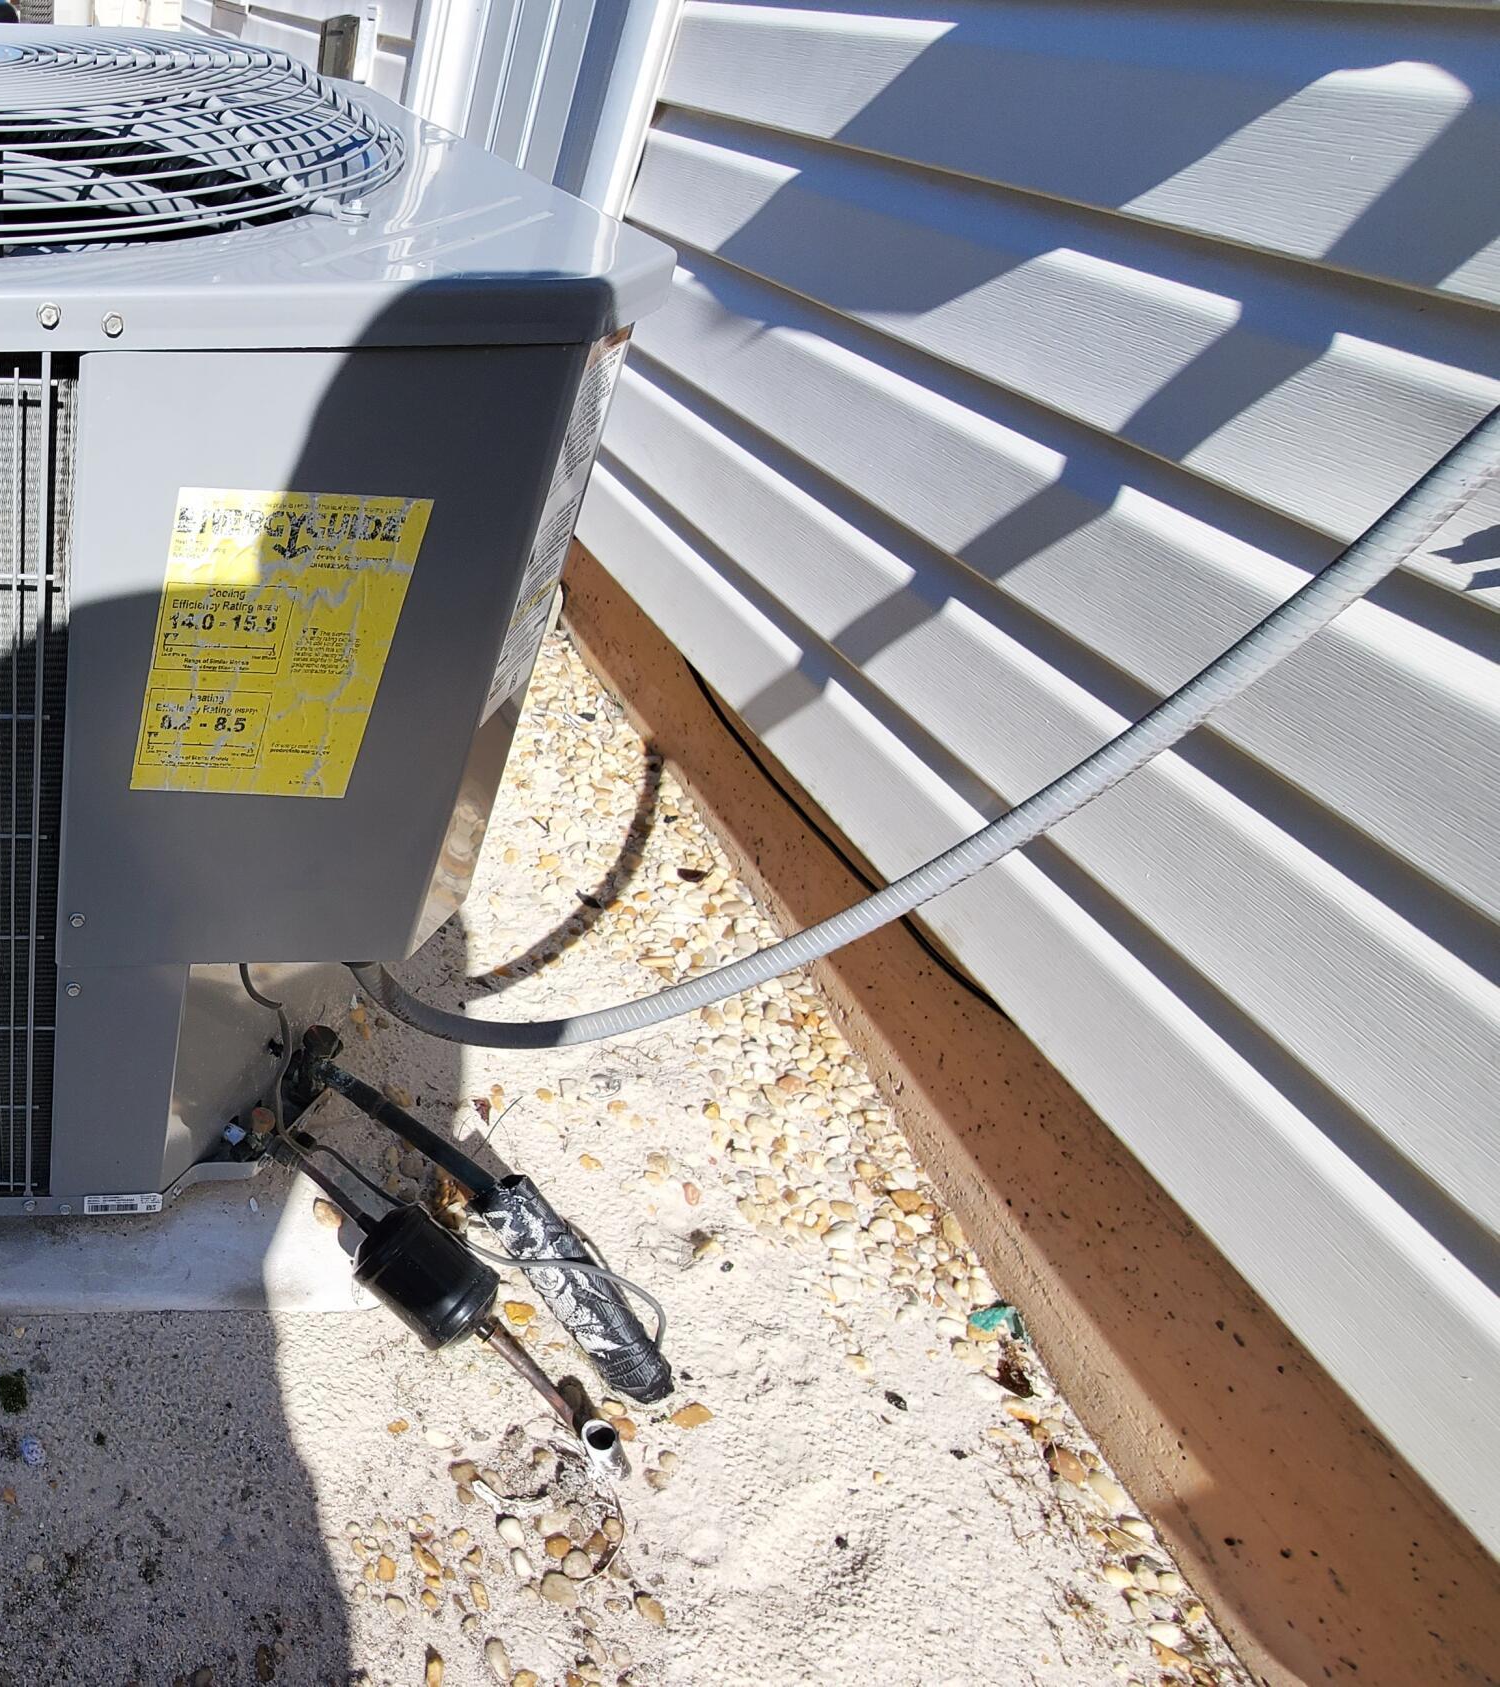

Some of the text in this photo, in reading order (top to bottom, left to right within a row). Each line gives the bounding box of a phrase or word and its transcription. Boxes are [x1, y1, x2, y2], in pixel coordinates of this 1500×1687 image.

[209, 588, 246, 600] Cooling
[172, 599, 221, 612] Efficiency
[222, 600, 254, 613] Rating
[169, 612, 215, 630] 14.0
[190, 693, 225, 704] Heating
[203, 704, 233, 716] Rating
[214, 716, 247, 733] 8.5
